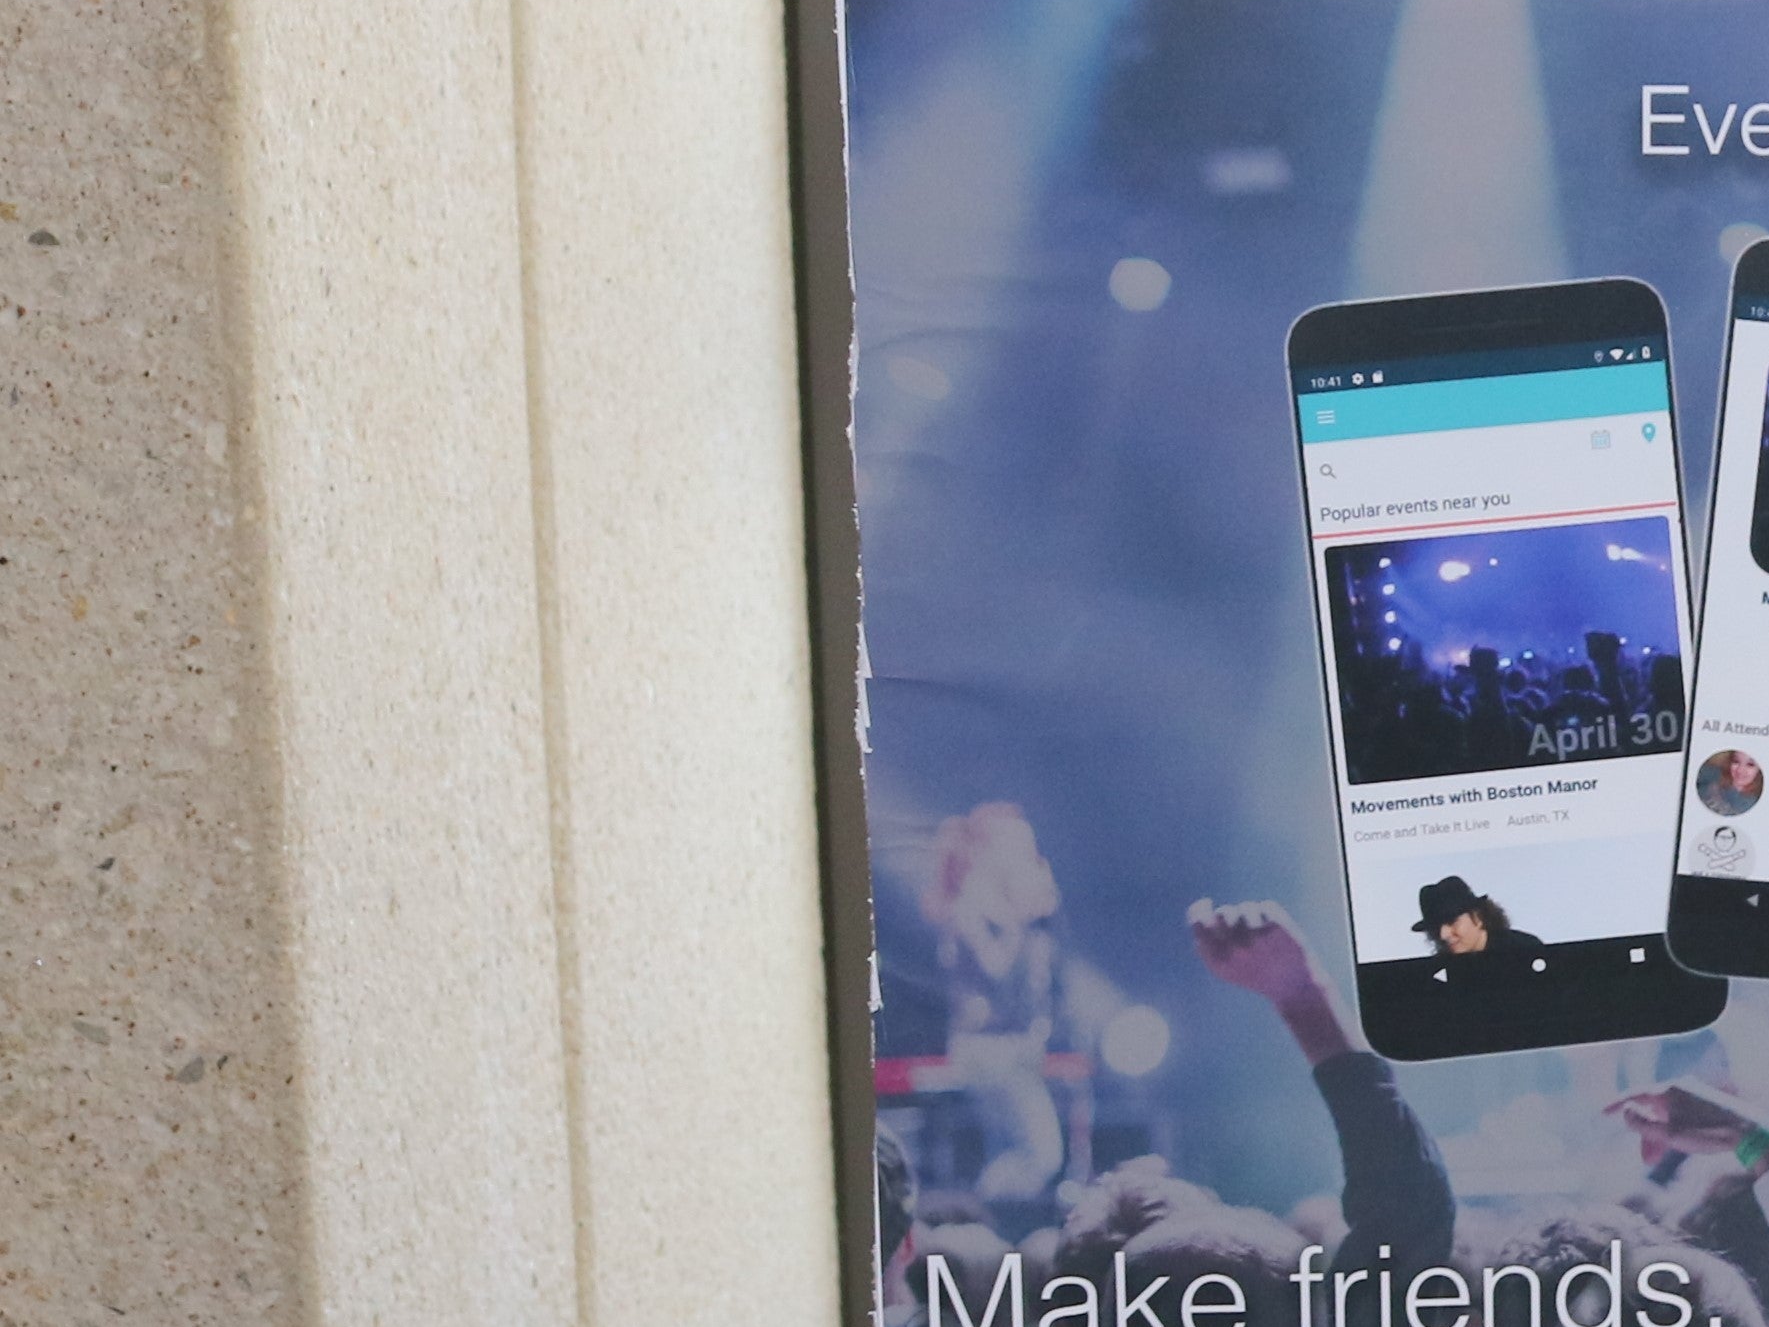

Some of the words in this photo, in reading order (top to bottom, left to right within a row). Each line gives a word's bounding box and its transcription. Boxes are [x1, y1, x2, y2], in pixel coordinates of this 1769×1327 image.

[1310, 375, 1342, 389] 10:41
[1320, 504, 1381, 523] Popular
[1386, 499, 1439, 516] events
[1442, 496, 1477, 511] near
[1481, 492, 1511, 511] you
[1527, 714, 1618, 762] April
[1631, 710, 1679, 746] 30
[1702, 720, 1721, 733] All
[1350, 793, 1445, 816] Movements
[1448, 789, 1483, 805] with
[1487, 783, 1543, 801] Boston
[1546, 778, 1599, 795] Manor
[1353, 829, 1391, 843] Come
[1393, 825, 1418, 840] and
[1421, 822, 1450, 836] Take
[1465, 818, 1491, 832] Live
[1552, 810, 1570, 822] TX
